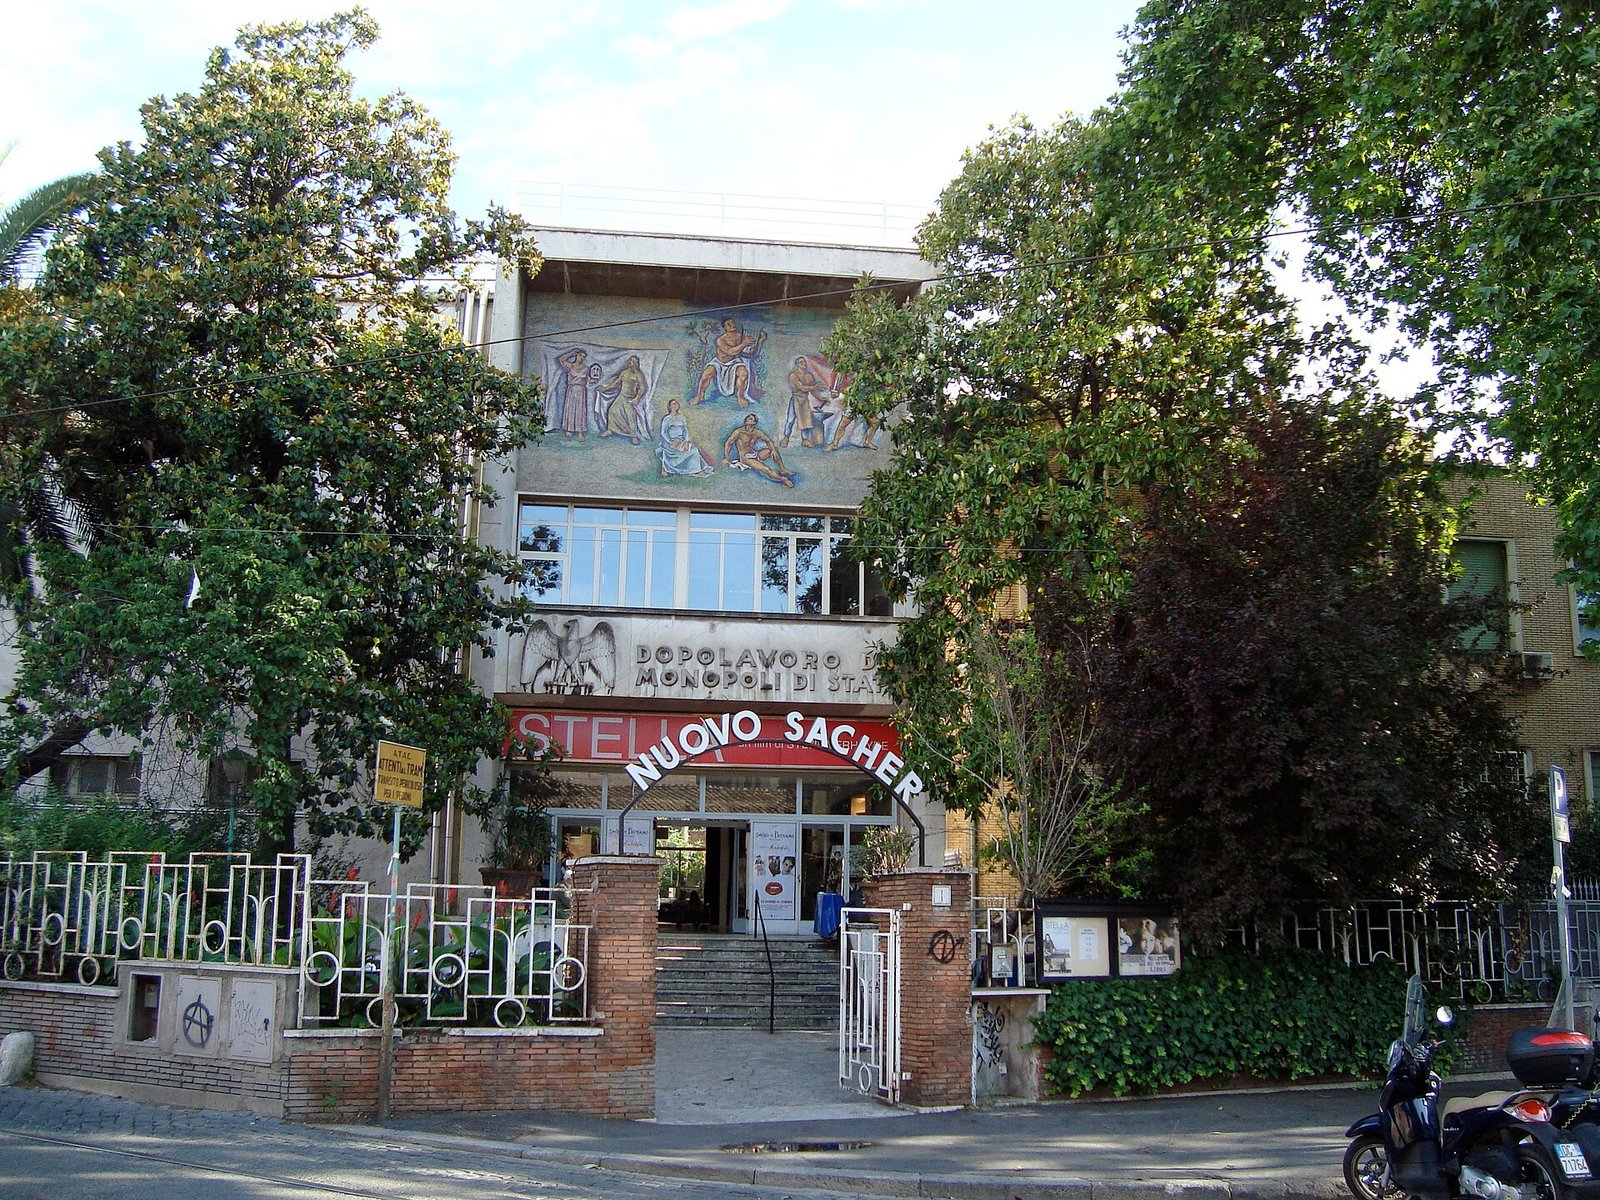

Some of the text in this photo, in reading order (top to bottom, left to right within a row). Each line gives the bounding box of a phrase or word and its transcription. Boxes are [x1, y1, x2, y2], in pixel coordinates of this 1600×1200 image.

[636, 645, 841, 670] DOPOLAVORO
[635, 667, 884, 694] MONOPOLI DI STAT
[407, 763, 423, 777] TRAM
[624, 710, 924, 805] NUOVO SACHER
[1553, 770, 1564, 810] P
[1045, 921, 1069, 929] STELLA
[1562, 1159, 1588, 1171] 71764
